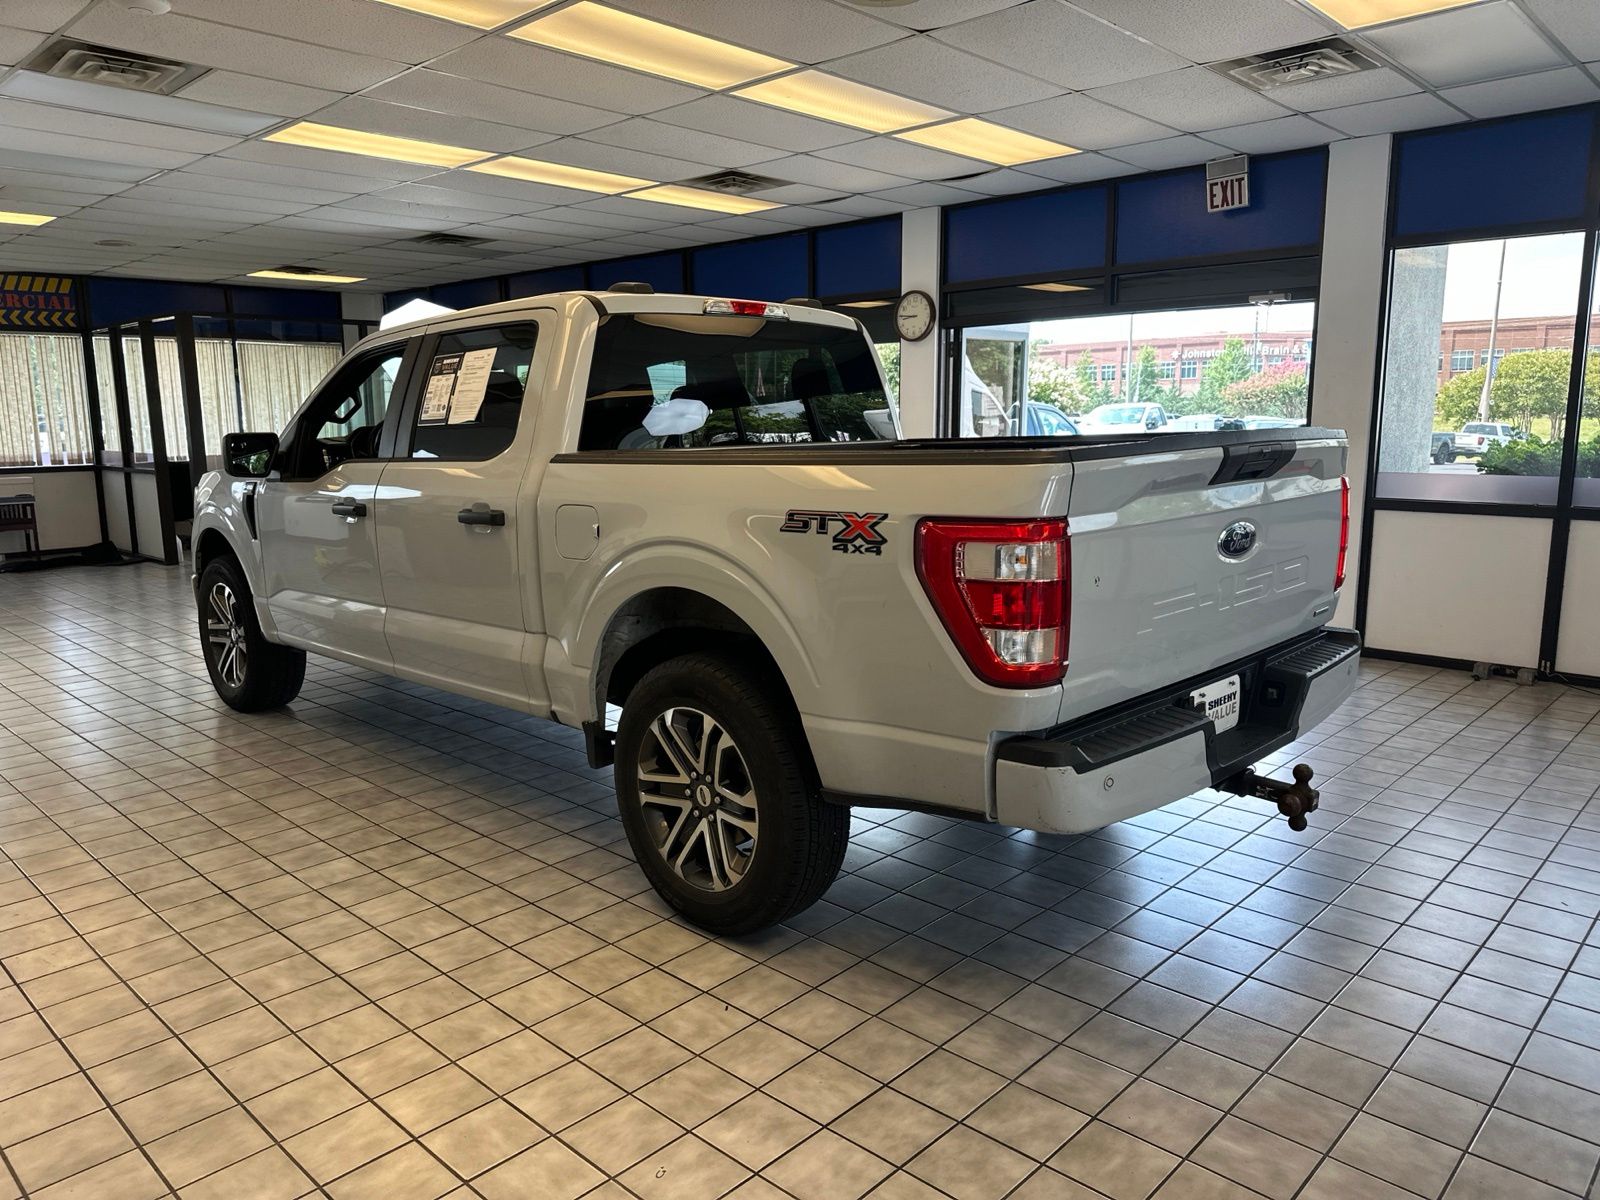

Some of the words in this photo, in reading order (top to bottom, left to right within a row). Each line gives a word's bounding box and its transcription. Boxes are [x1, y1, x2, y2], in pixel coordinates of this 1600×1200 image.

[1210, 177, 1245, 210] EXIT
[1262, 345, 1290, 356] Brain
[780, 509, 889, 545] STX
[1208, 691, 1238, 711] SHEEHY
